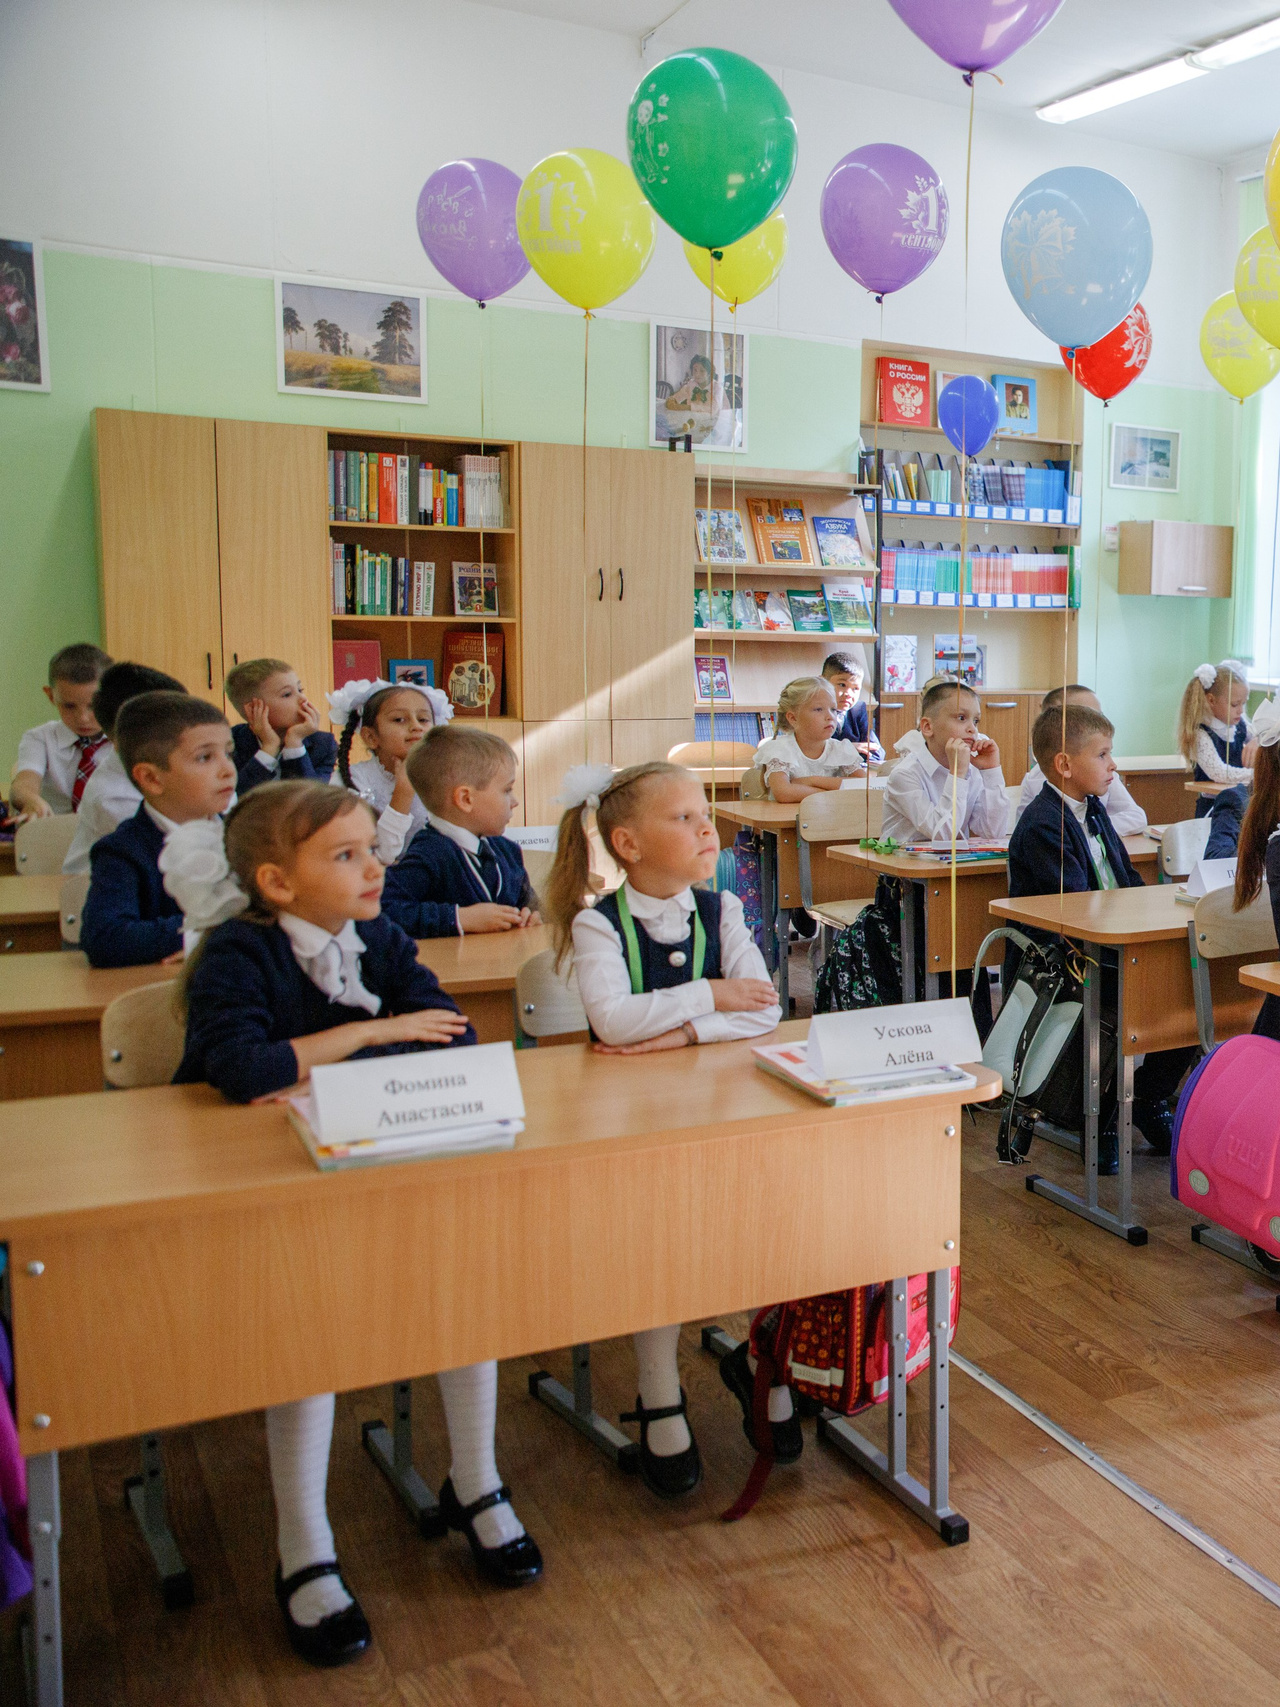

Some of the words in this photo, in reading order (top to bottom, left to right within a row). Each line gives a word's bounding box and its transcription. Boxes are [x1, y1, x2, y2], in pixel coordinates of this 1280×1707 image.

[921, 186, 939, 233] 1
[889, 362, 913, 373] КНИГА
[896, 371, 926, 382] РОССИИ
[756, 515, 764, 523] Б
[825, 523, 848, 531] АЗБУКА
[873, 1022, 933, 1041] Ускова
[884, 1049, 935, 1067] Алёна
[383, 1073, 468, 1096] Фомина
[377, 1099, 485, 1129] Анастасия
